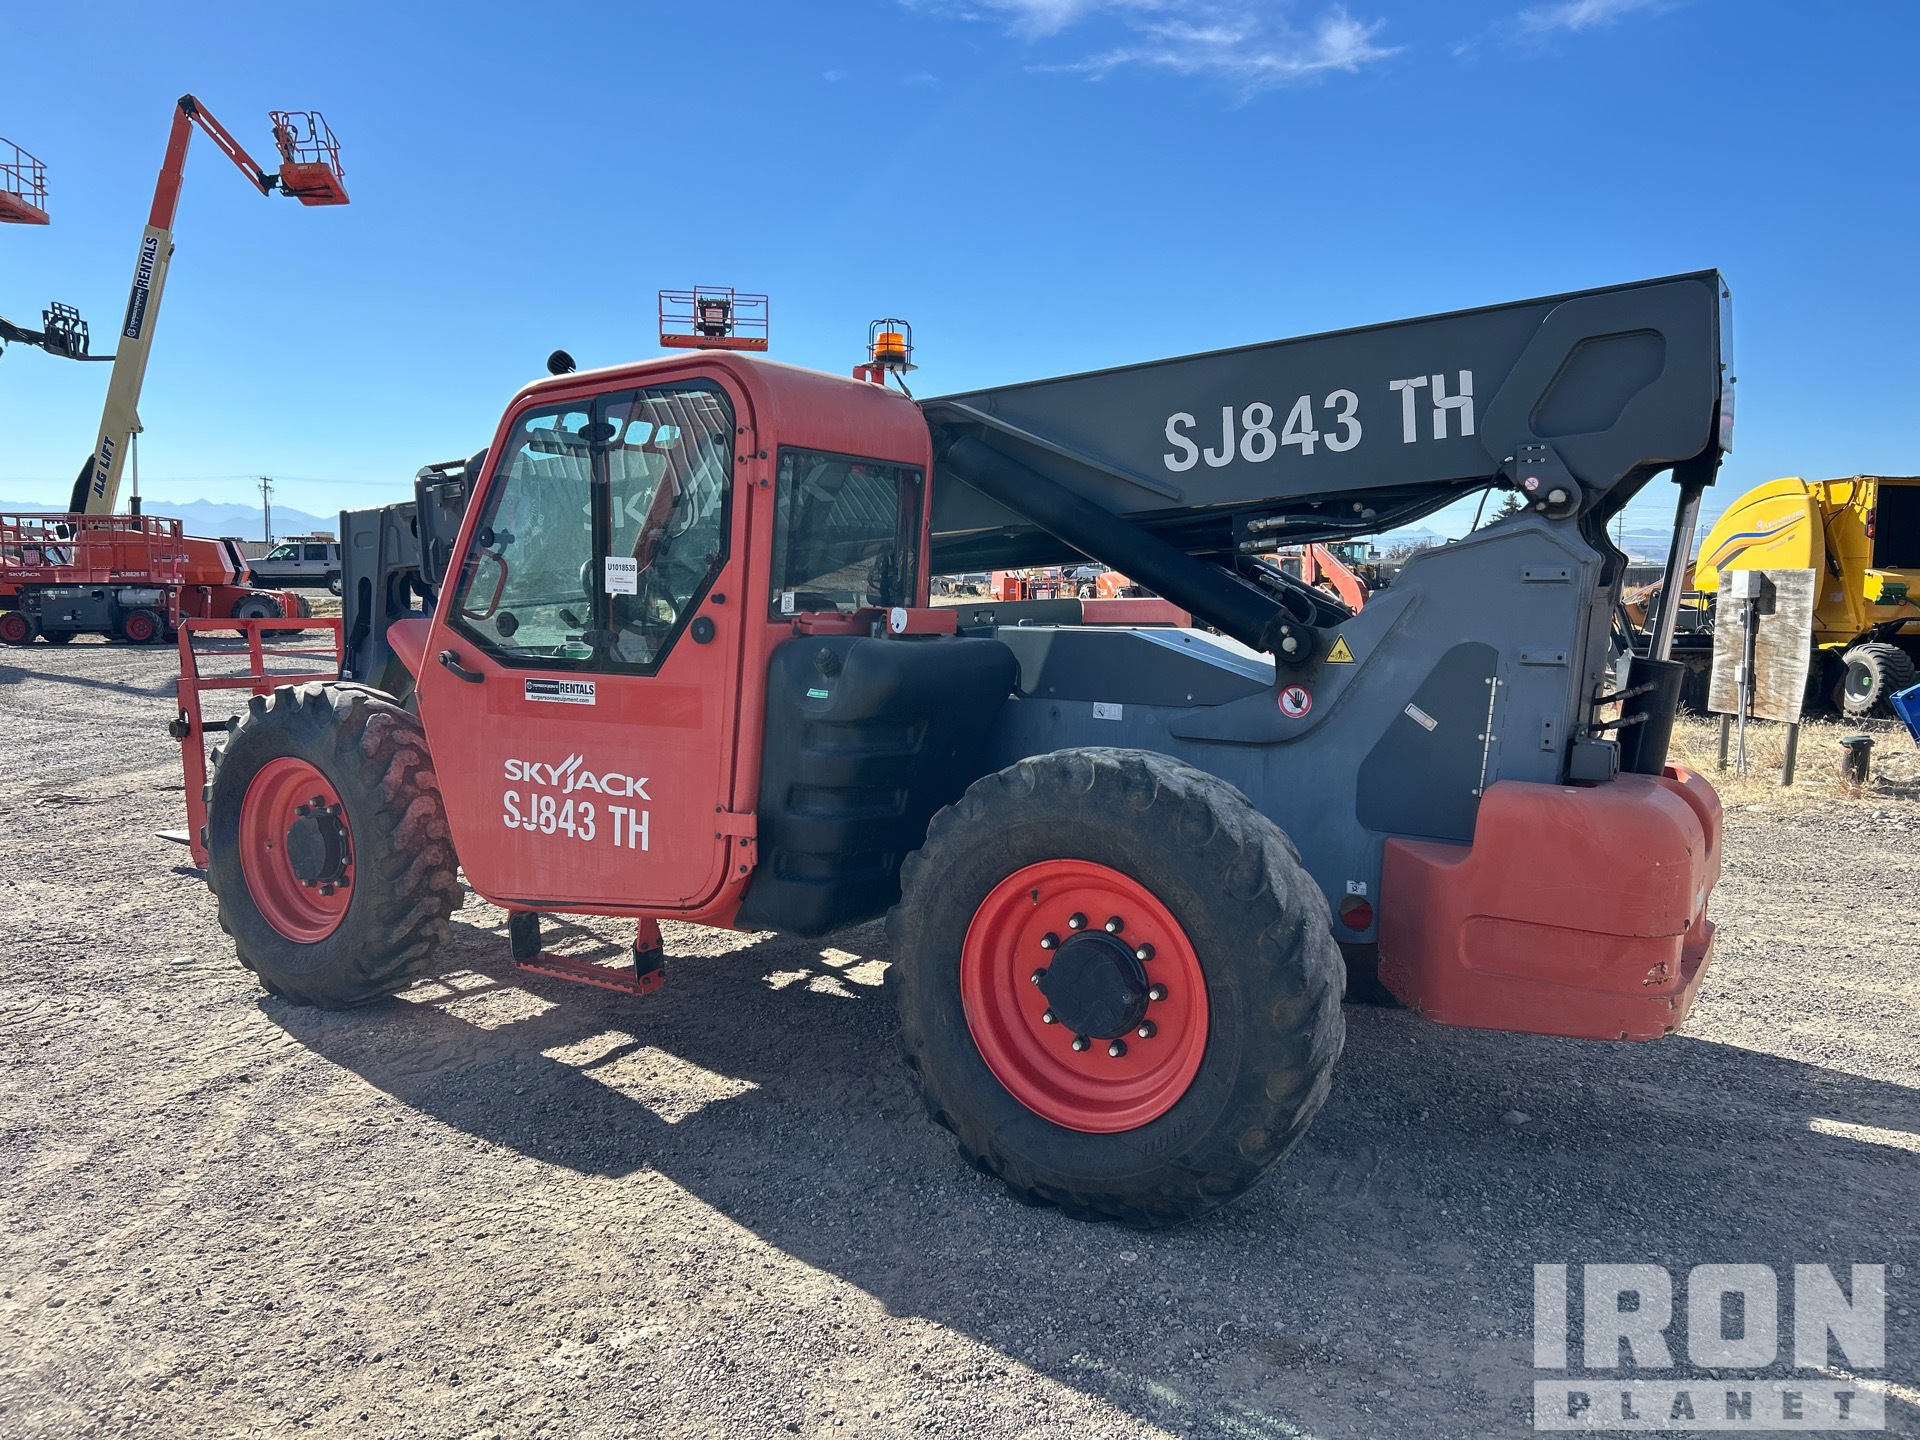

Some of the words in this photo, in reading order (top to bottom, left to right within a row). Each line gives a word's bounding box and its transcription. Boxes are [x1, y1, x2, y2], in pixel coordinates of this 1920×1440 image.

[136, 236, 158, 289] RENTALS
[1163, 388, 1363, 472] SJ843
[1389, 369, 1475, 443] TH
[99, 435, 115, 470] LIFT
[93, 470, 107, 499] JLG
[607, 563, 636, 572] U1018538
[560, 683, 595, 695] RENTALS
[504, 752, 653, 801] SKYJACK
[503, 790, 596, 841] SJ843
[608, 804, 649, 851] TH
